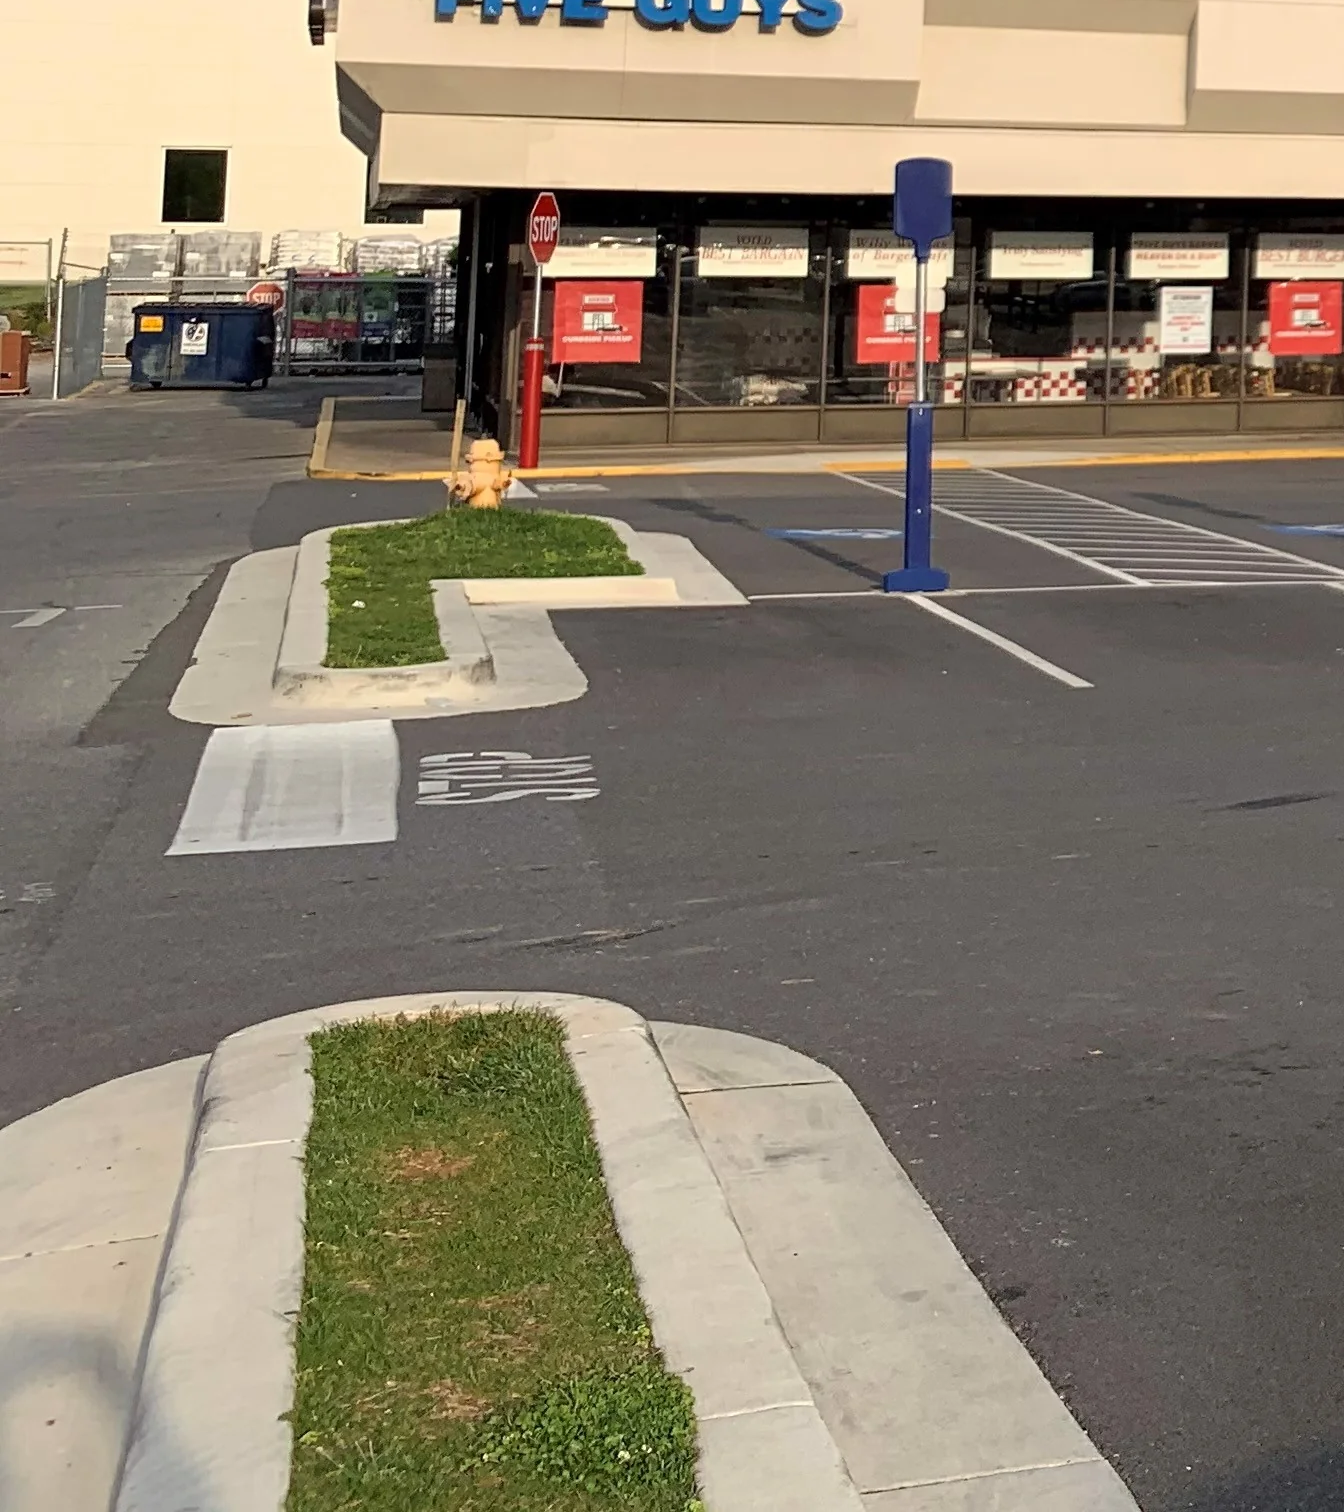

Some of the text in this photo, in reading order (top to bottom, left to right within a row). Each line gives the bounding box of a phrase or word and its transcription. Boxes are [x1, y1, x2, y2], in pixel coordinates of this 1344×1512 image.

[531, 215, 558, 243] STOP
[252, 292, 281, 304] STOP
[414, 751, 601, 805] STOP
